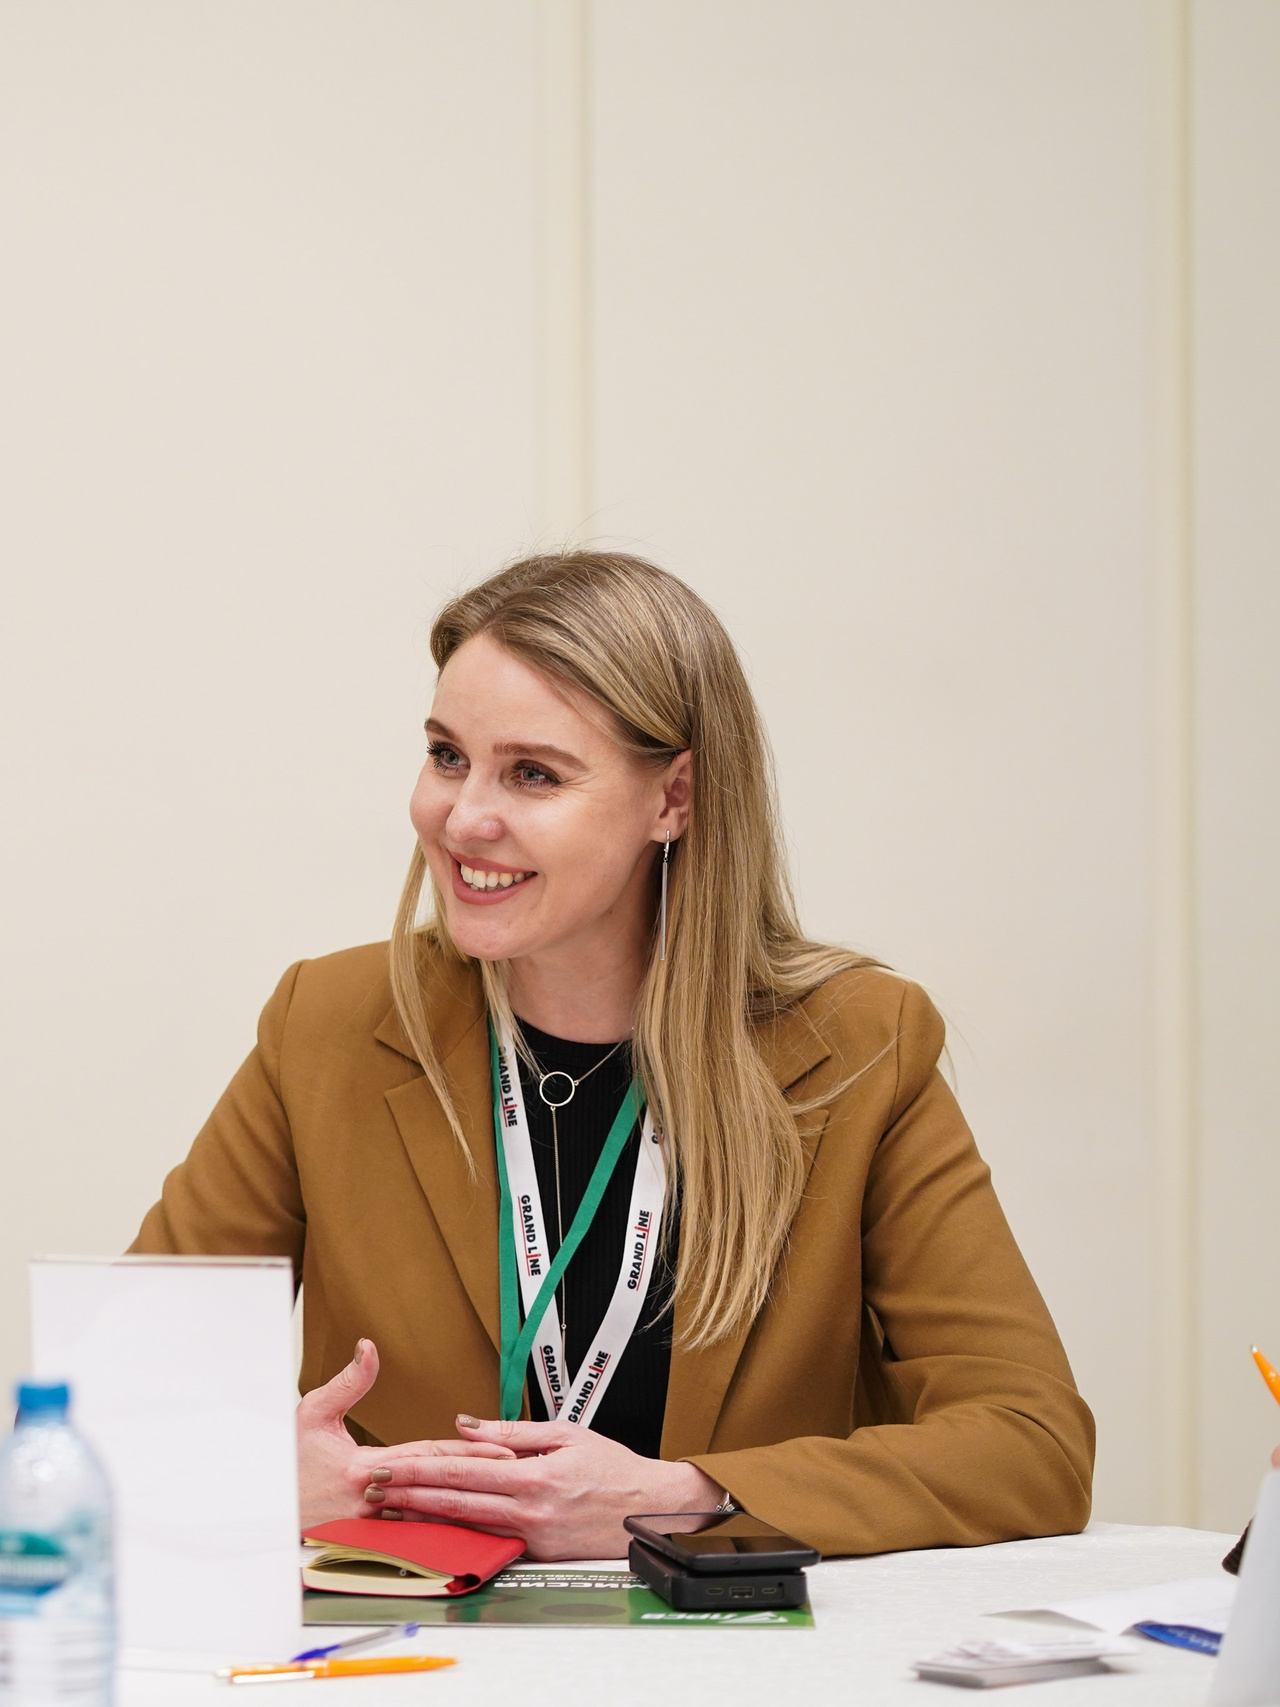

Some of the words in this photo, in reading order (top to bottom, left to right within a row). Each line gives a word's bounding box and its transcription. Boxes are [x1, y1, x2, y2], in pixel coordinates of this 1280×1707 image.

[504, 1097, 518, 1127] LINE
[521, 1195, 536, 1243] GRAND
[634, 1210, 650, 1240] LINE
[528, 1246, 542, 1276] LINE
[627, 1242, 644, 1289] GRAND
[543, 1345, 561, 1393] GRAND
[568, 1380, 594, 1423] GRAND
[588, 1350, 609, 1379] LINE
